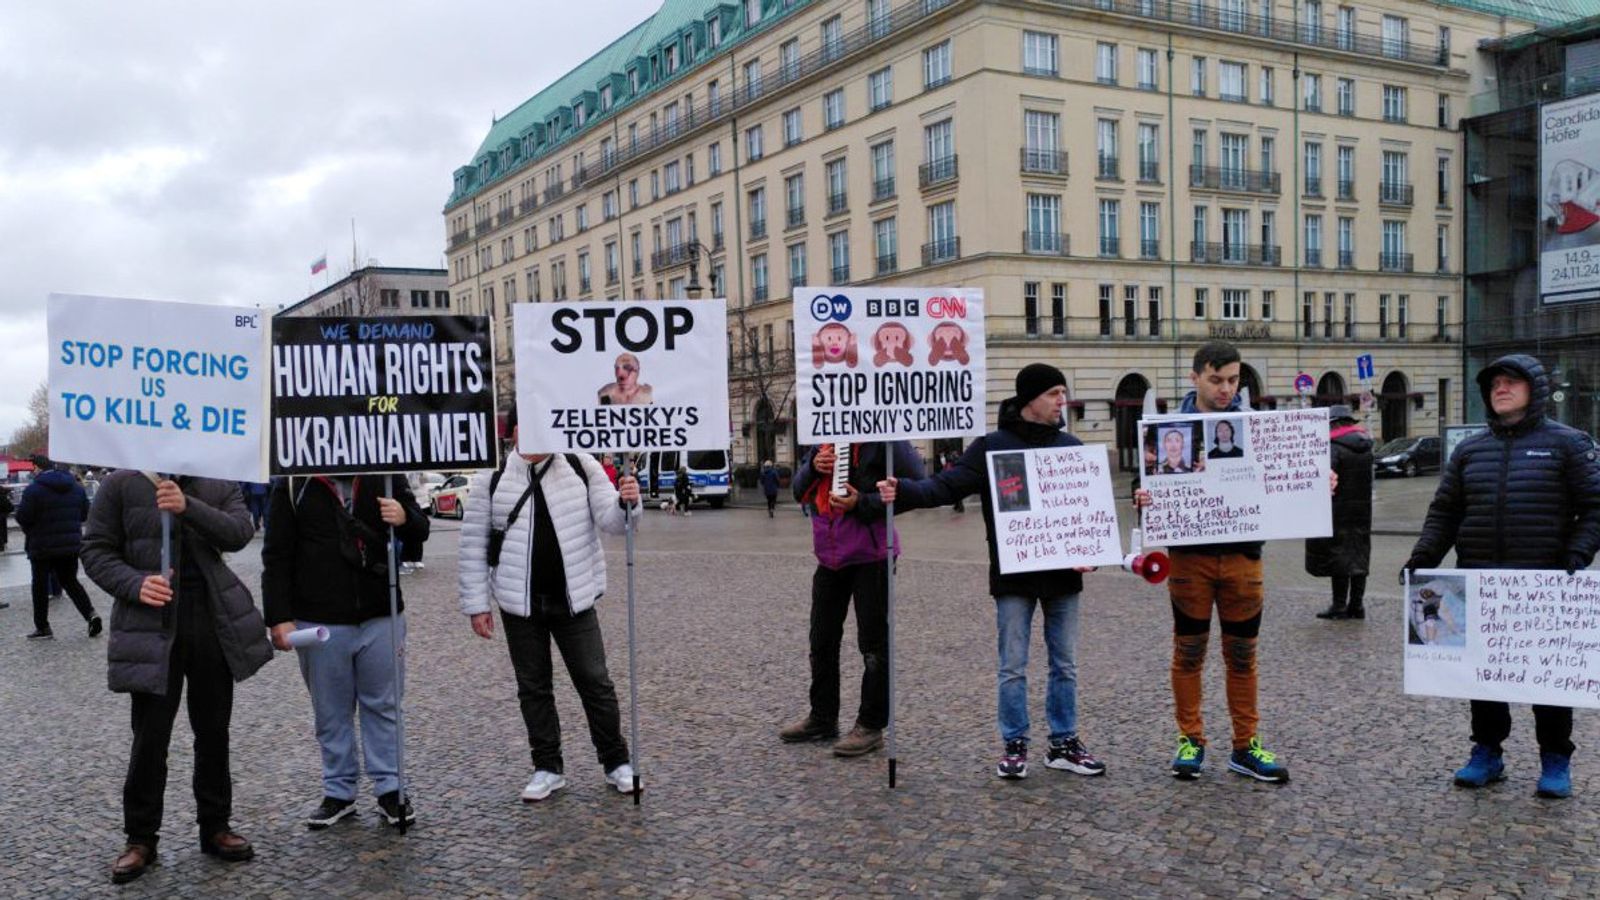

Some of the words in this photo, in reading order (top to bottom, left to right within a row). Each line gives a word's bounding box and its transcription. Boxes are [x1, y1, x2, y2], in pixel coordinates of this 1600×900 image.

[1545, 108, 1600, 130] Candida
[811, 294, 852, 321] DW
[926, 296, 966, 319] CNN
[320, 323, 350, 339] WE
[358, 323, 434, 340] DEMAND
[550, 306, 694, 354] STOP
[61, 340, 123, 368] STOP
[132, 347, 249, 380] FORCING
[273, 343, 378, 397] HUMAN
[384, 342, 483, 394] RIGHTS
[141, 377, 165, 397] US
[812, 372, 868, 407] STOP
[874, 369, 973, 405] IGNORING
[61, 392, 96, 421] TO
[105, 397, 162, 427] KILL
[171, 403, 191, 430] &
[202, 405, 246, 436] DIE
[368, 396, 399, 413] FOR
[551, 406, 699, 429] ZELENSKY'S
[811, 408, 913, 436] ZELENSKIY'S
[917, 406, 974, 432] CRIMES
[275, 414, 422, 467] UKRAINIAN
[428, 412, 488, 462] MEN
[563, 427, 688, 449] TORTURES
[1145, 511, 1161, 524] to
[1166, 511, 1191, 523] the
[1479, 572, 1496, 586] he
[1479, 588, 1498, 600] but
[1507, 588, 1522, 601] he
[1480, 602, 1496, 621] by
[1533, 669, 1552, 688] of
